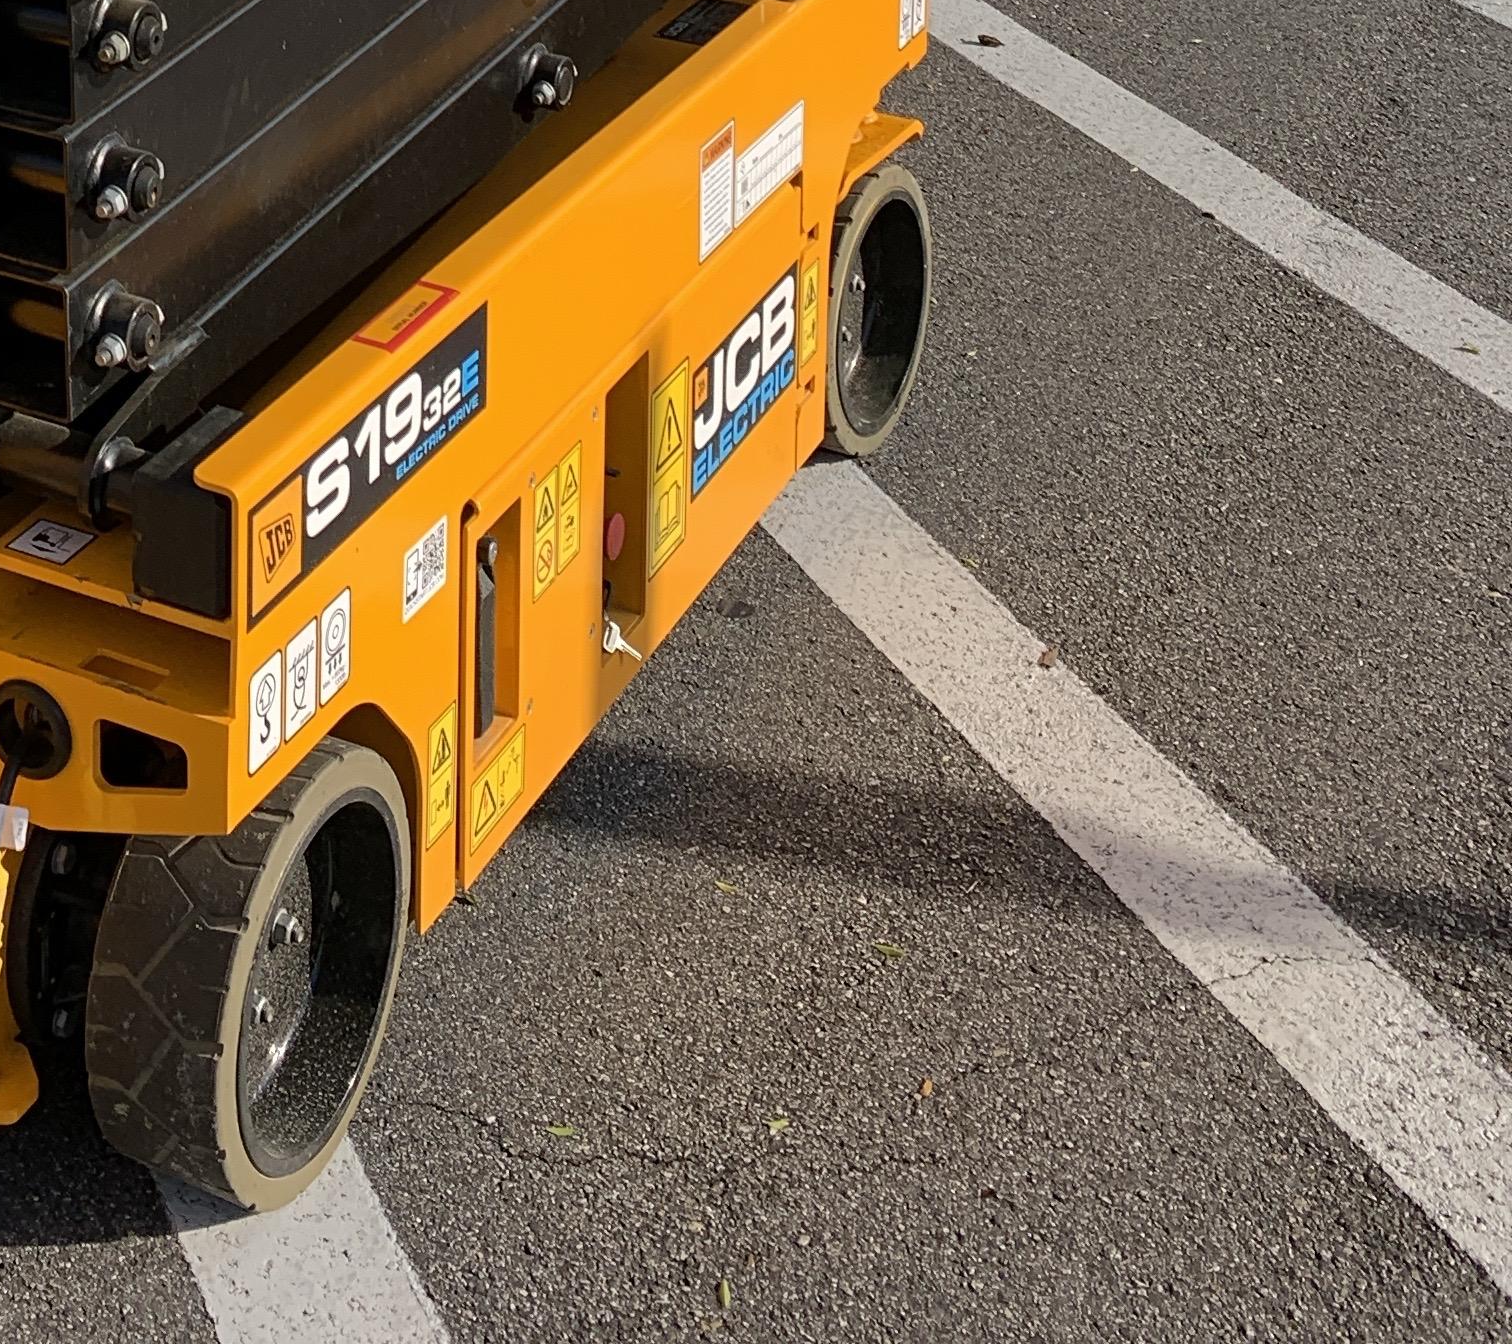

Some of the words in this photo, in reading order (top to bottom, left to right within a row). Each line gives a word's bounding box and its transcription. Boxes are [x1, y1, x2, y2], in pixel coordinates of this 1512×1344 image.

[694, 274, 795, 450] JCB
[395, 423, 447, 481] ELECTRIC
[447, 392, 480, 432] DRIVE
[692, 349, 795, 495] ELECTRIC
[264, 519, 294, 576] JCB
